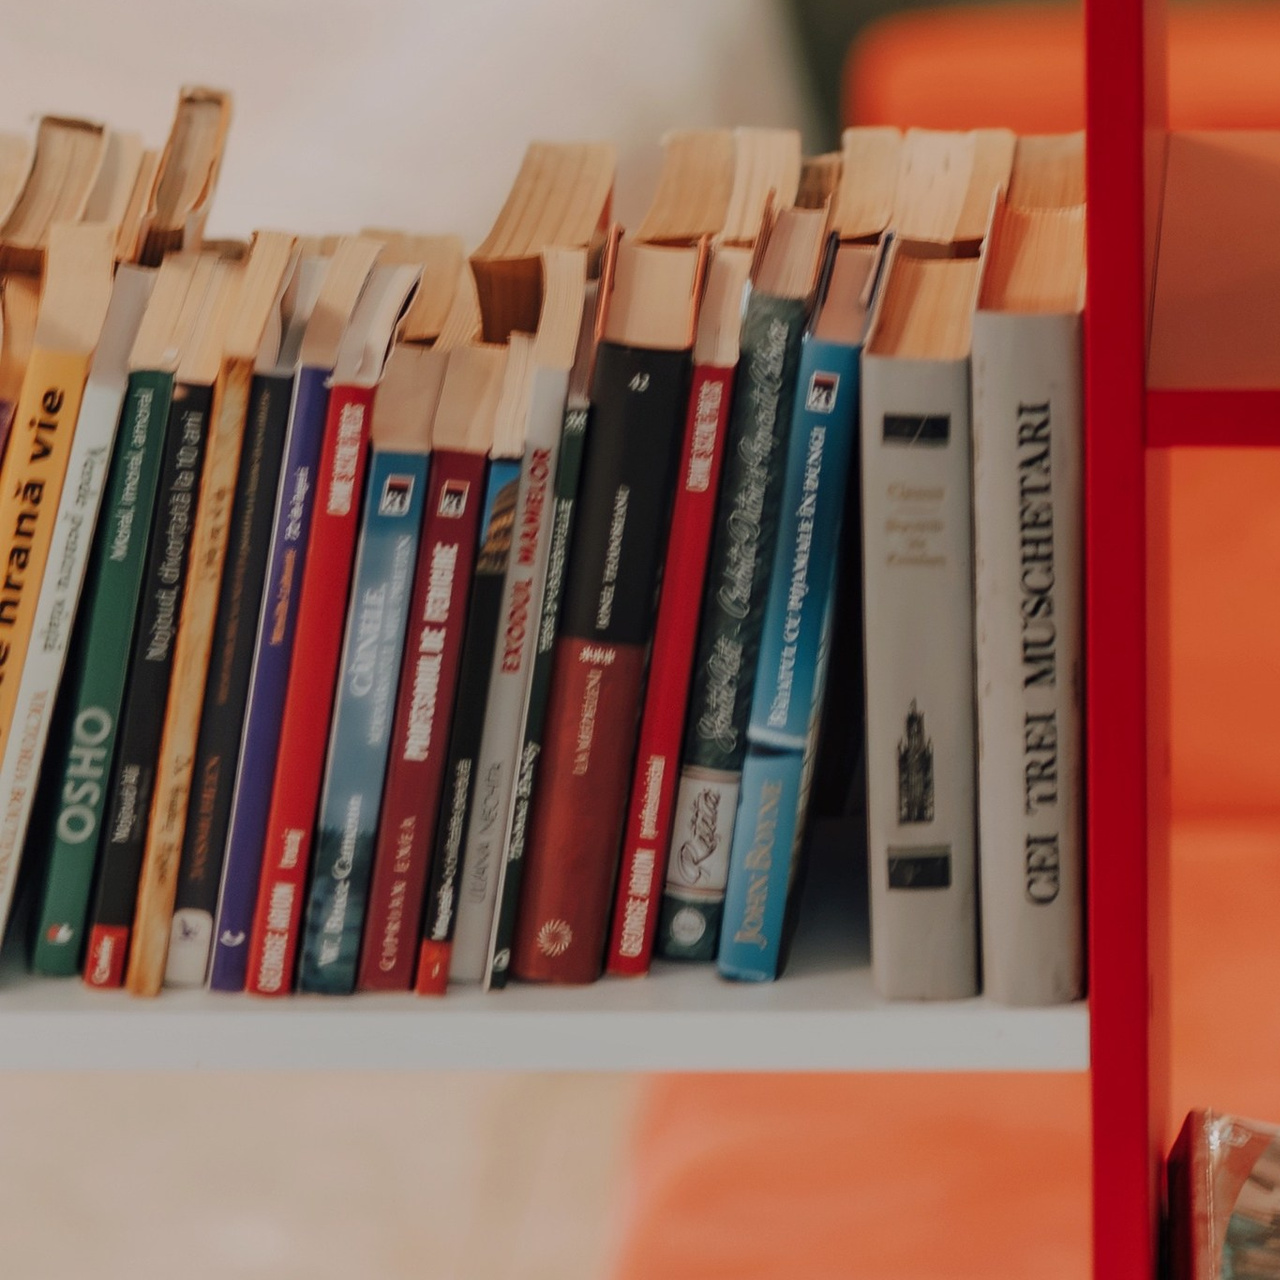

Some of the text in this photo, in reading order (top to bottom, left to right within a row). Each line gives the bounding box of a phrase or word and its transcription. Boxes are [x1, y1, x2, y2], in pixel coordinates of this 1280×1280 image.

[25, 386, 63, 467] vie
[499, 444, 552, 675] EXODUL MAMELOR
[1019, 400, 1060, 907] CEI TREI MUSCHETARI
[53, 703, 114, 847] OSHO
[733, 777, 783, 949] JOHN BOYNE
